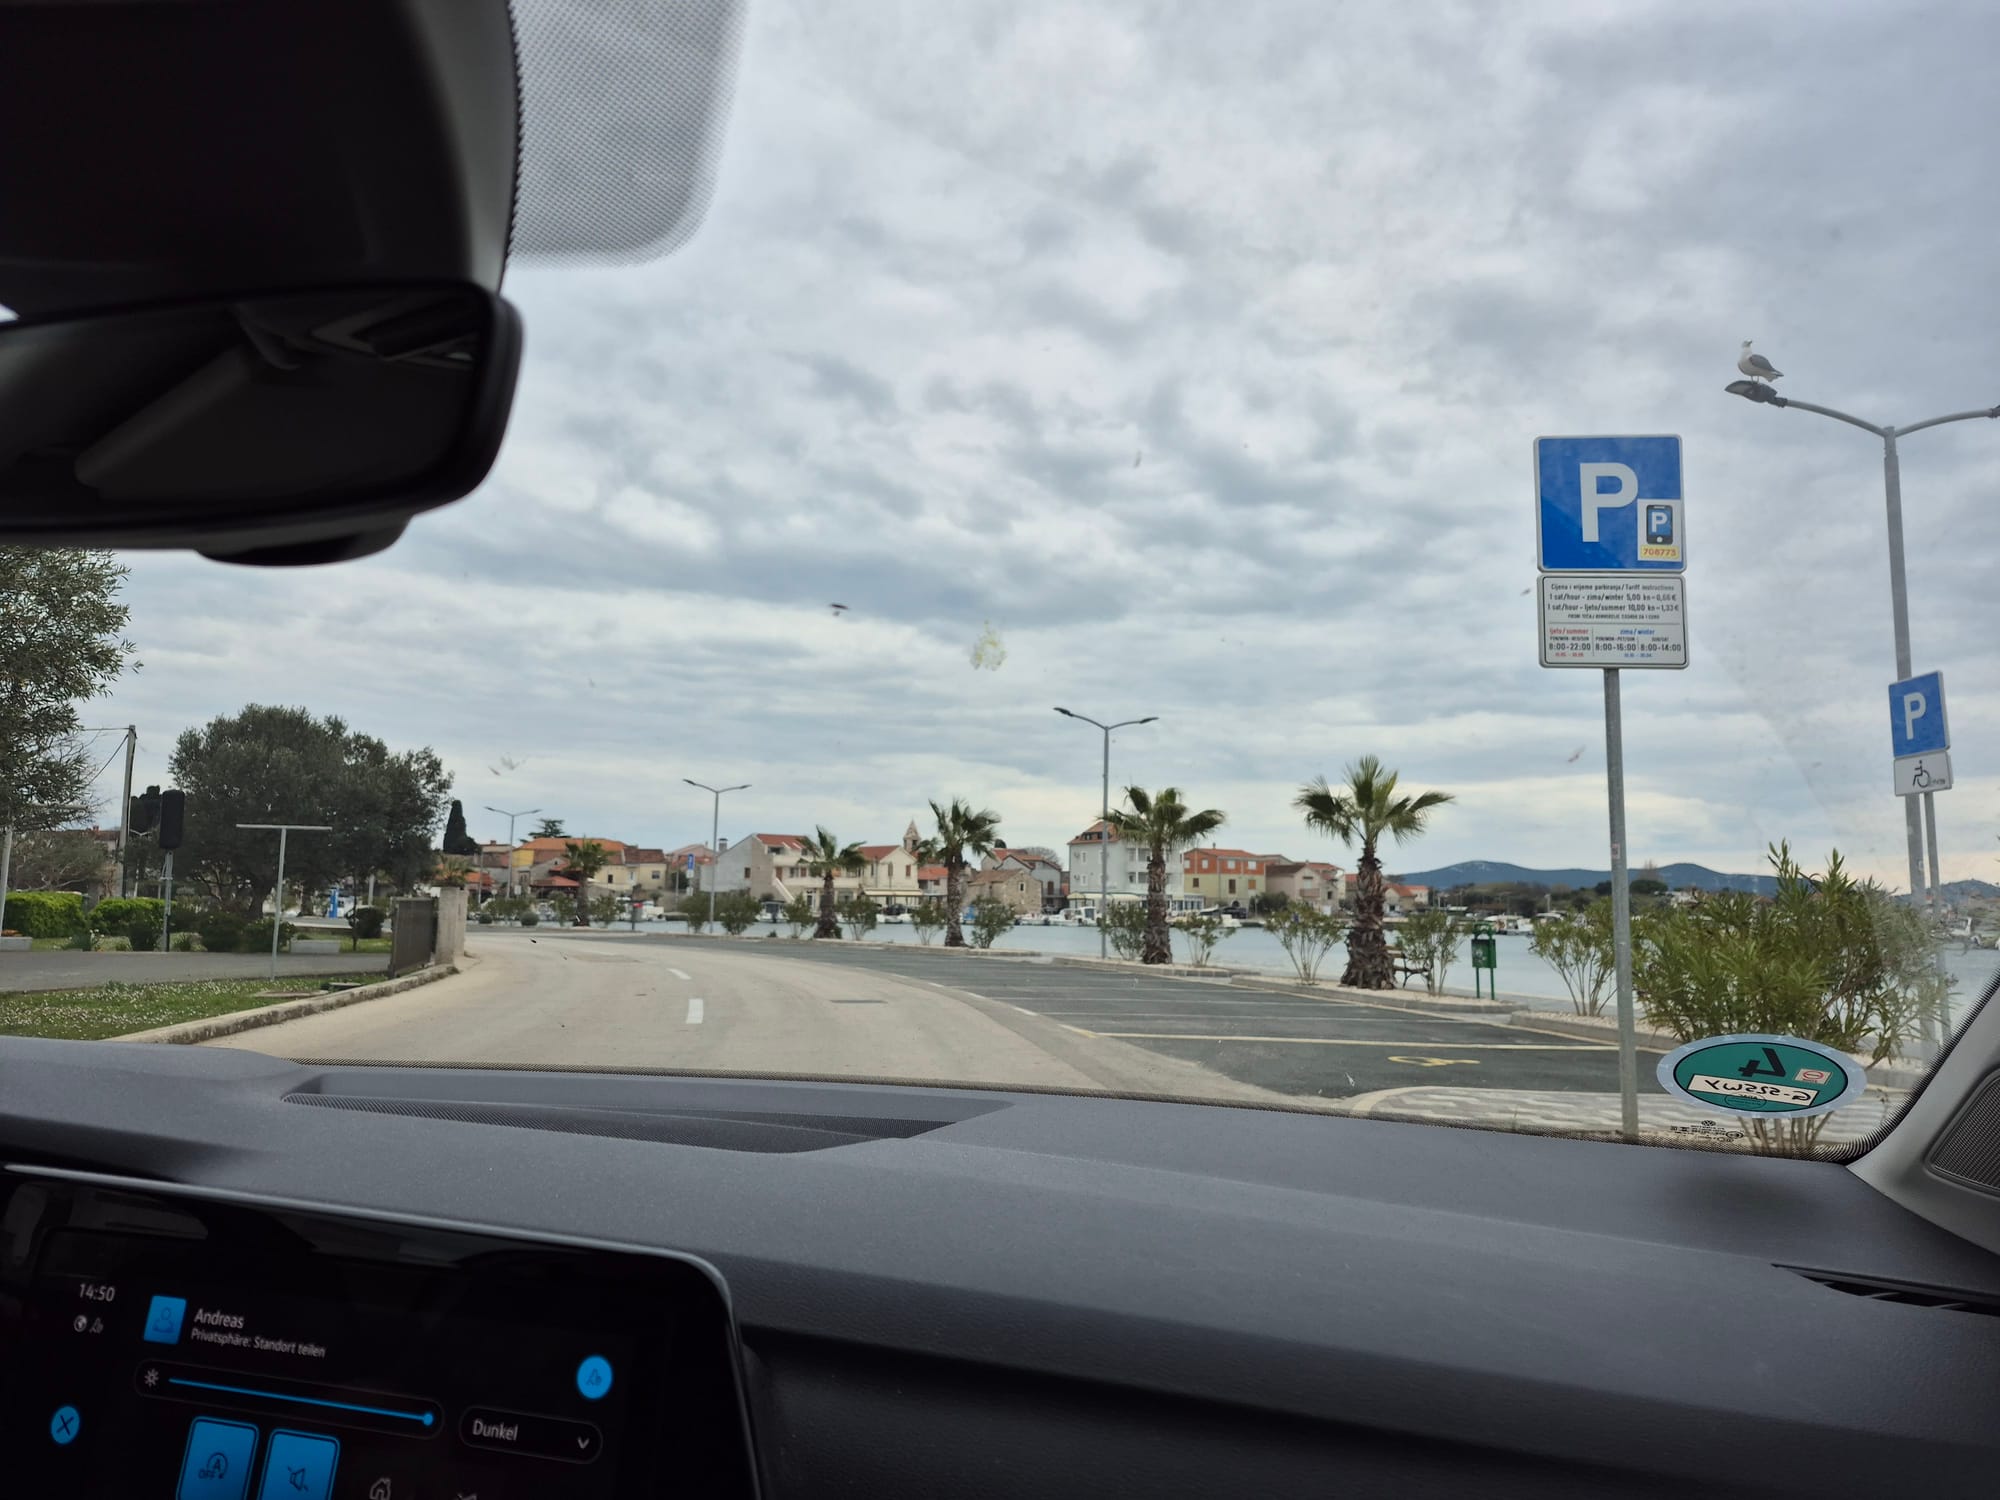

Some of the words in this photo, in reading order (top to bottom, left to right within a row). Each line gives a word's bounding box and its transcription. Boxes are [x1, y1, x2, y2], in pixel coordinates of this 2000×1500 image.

[1580, 462, 1638, 543] P
[1651, 512, 1668, 533] P
[1903, 692, 1927, 741] P
[79, 1283, 116, 1302] 14:50
[193, 1308, 245, 1329] Andreas
[190, 1327, 252, 1349] Privatsphäre:
[253, 1335, 296, 1354] Standort
[297, 1343, 327, 1359] teilen
[472, 1418, 519, 1442] Dunkel
